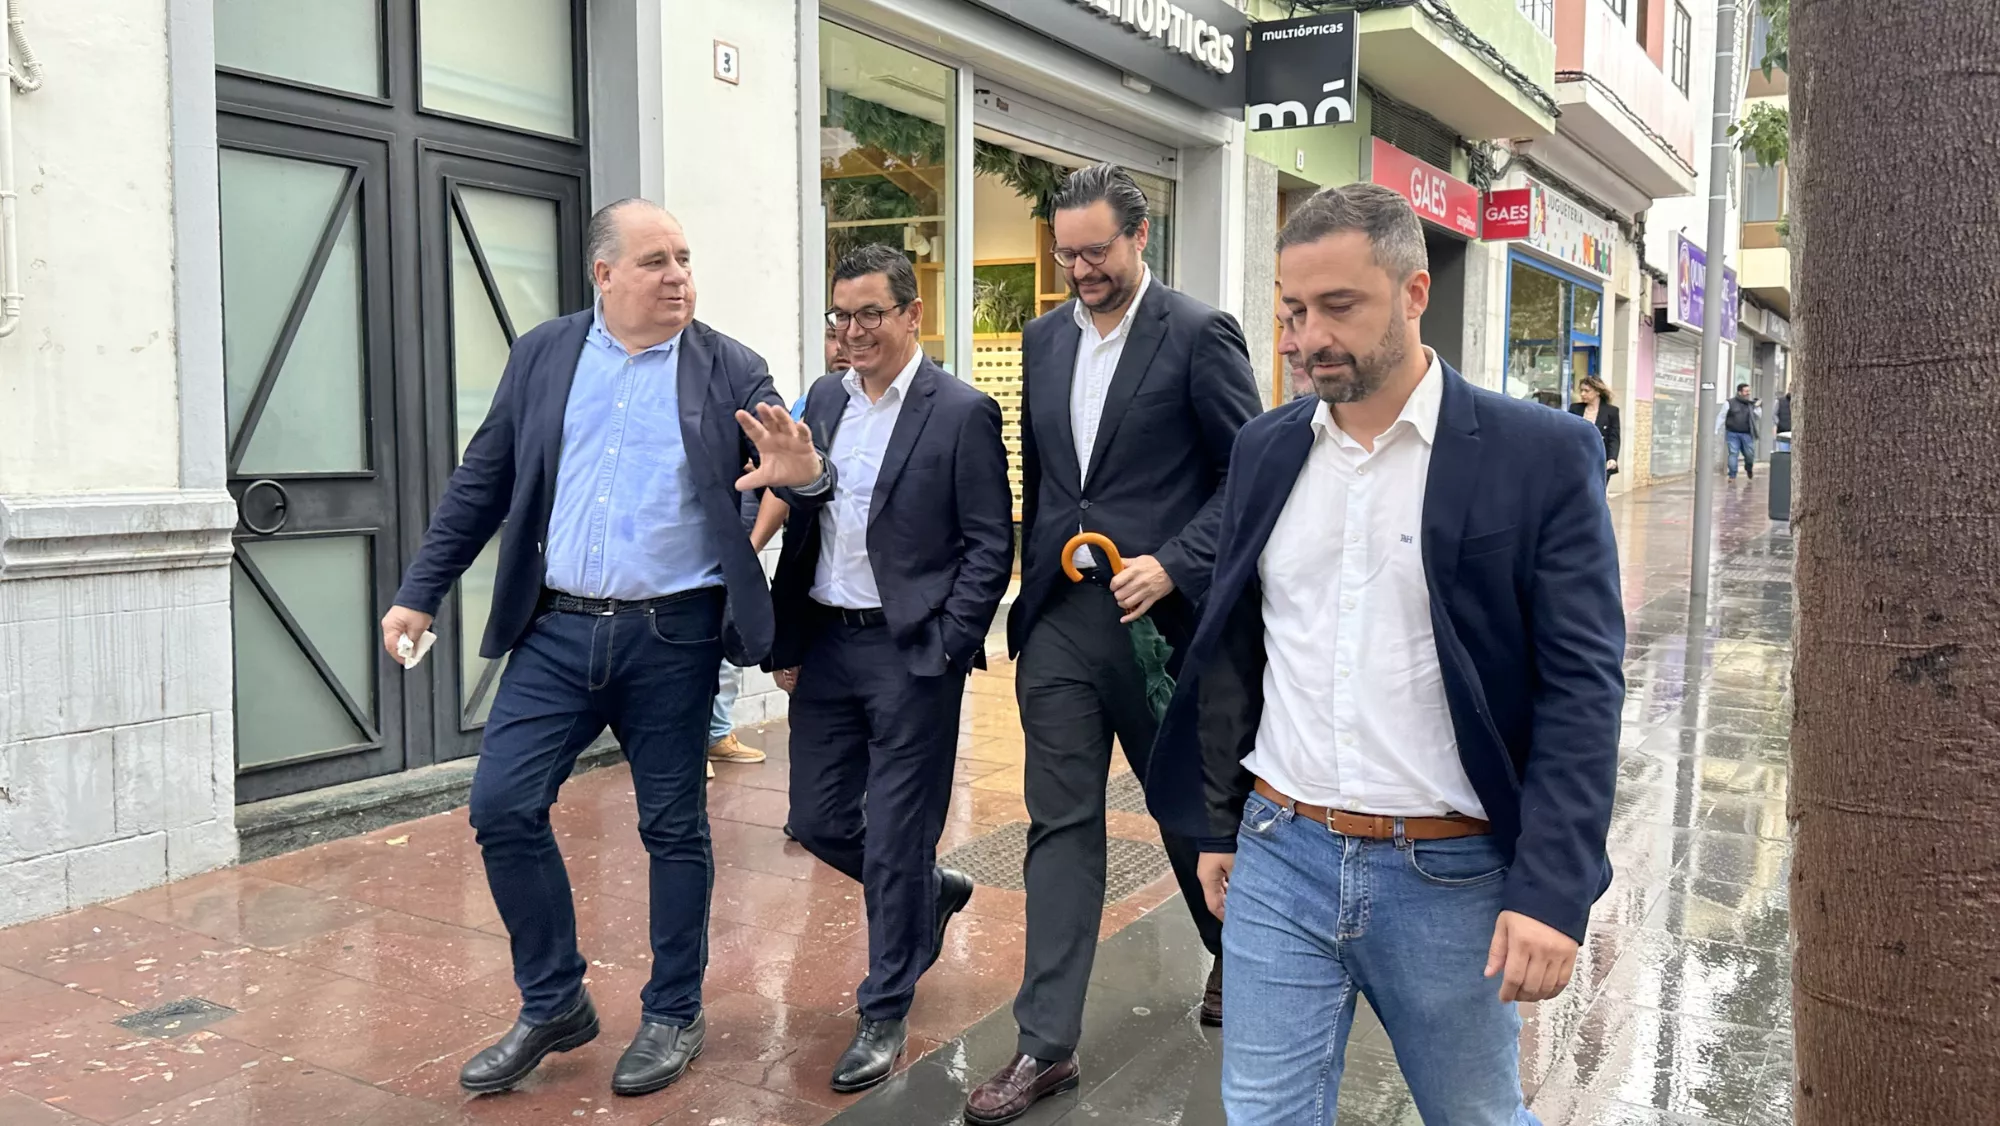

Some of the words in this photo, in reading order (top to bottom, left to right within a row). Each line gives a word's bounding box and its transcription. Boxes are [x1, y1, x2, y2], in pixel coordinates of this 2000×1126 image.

[723, 52, 732, 74] 3
[1410, 167, 1447, 218] GAES
[1485, 205, 1529, 221] GAES
